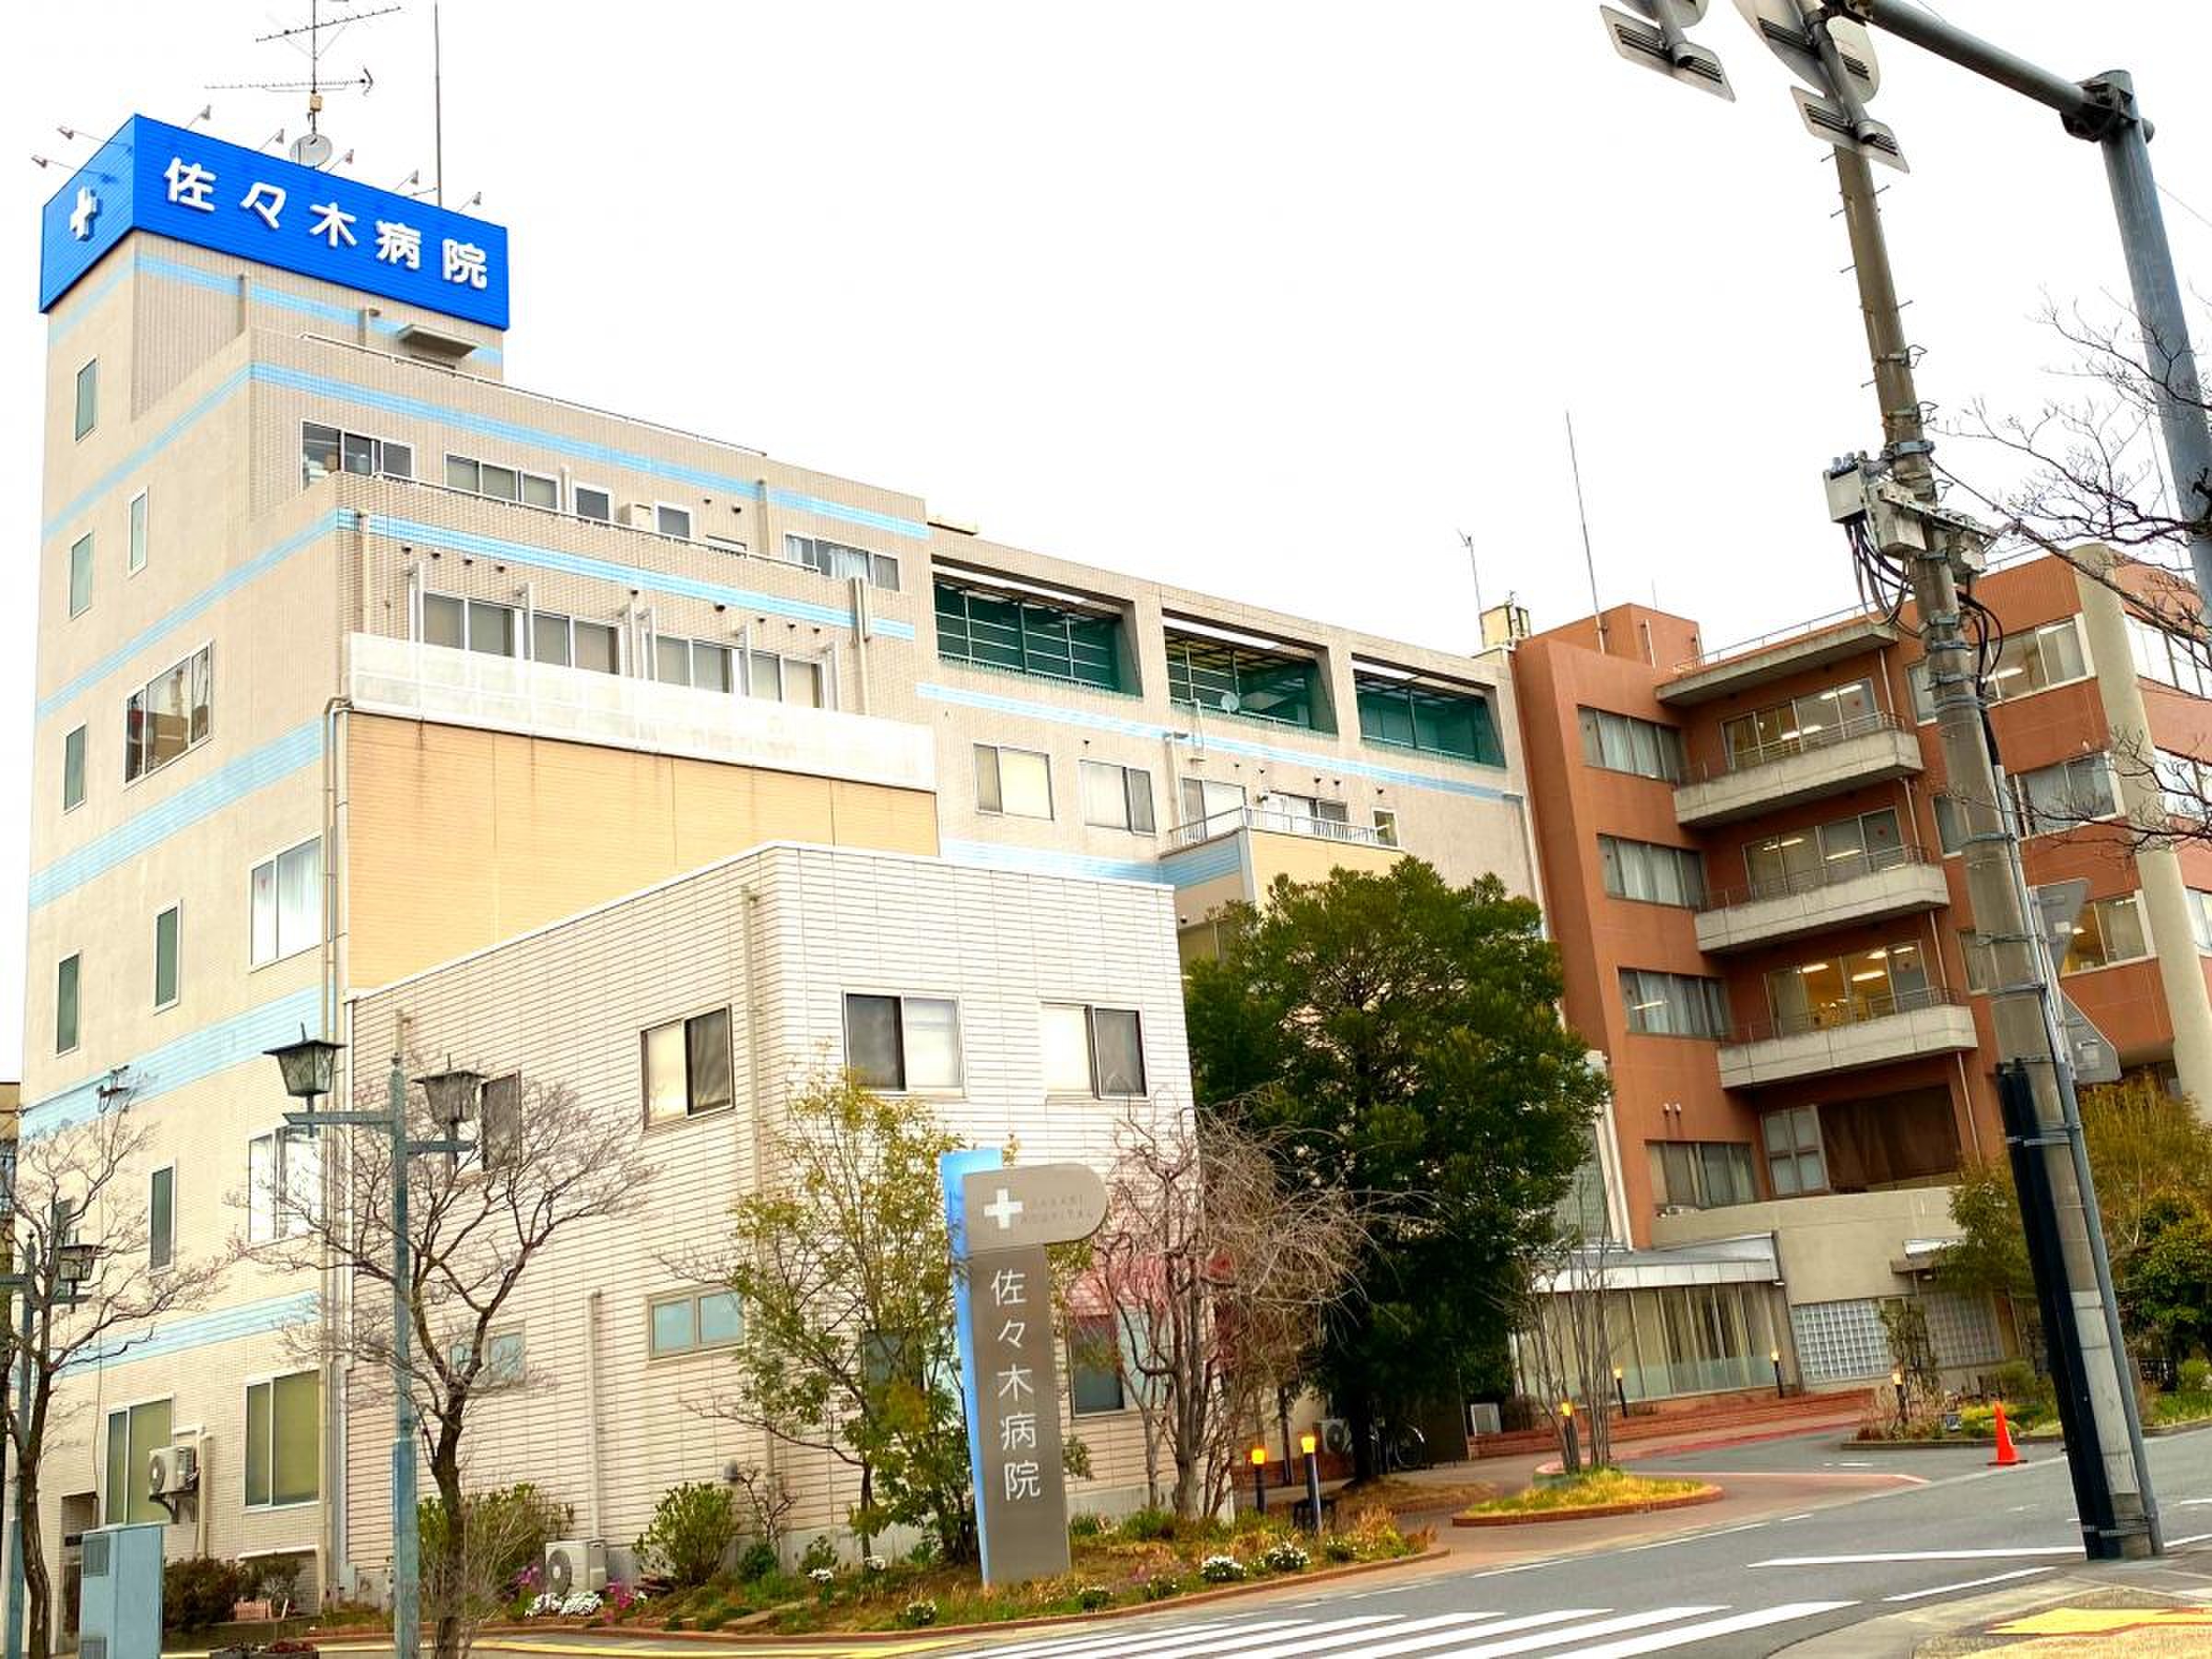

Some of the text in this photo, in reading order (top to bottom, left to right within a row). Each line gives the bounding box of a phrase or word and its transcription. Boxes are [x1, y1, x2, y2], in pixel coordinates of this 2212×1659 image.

[165, 158, 487, 288] 佐々木病院
[991, 1268, 1041, 1500] 佐々木病院
